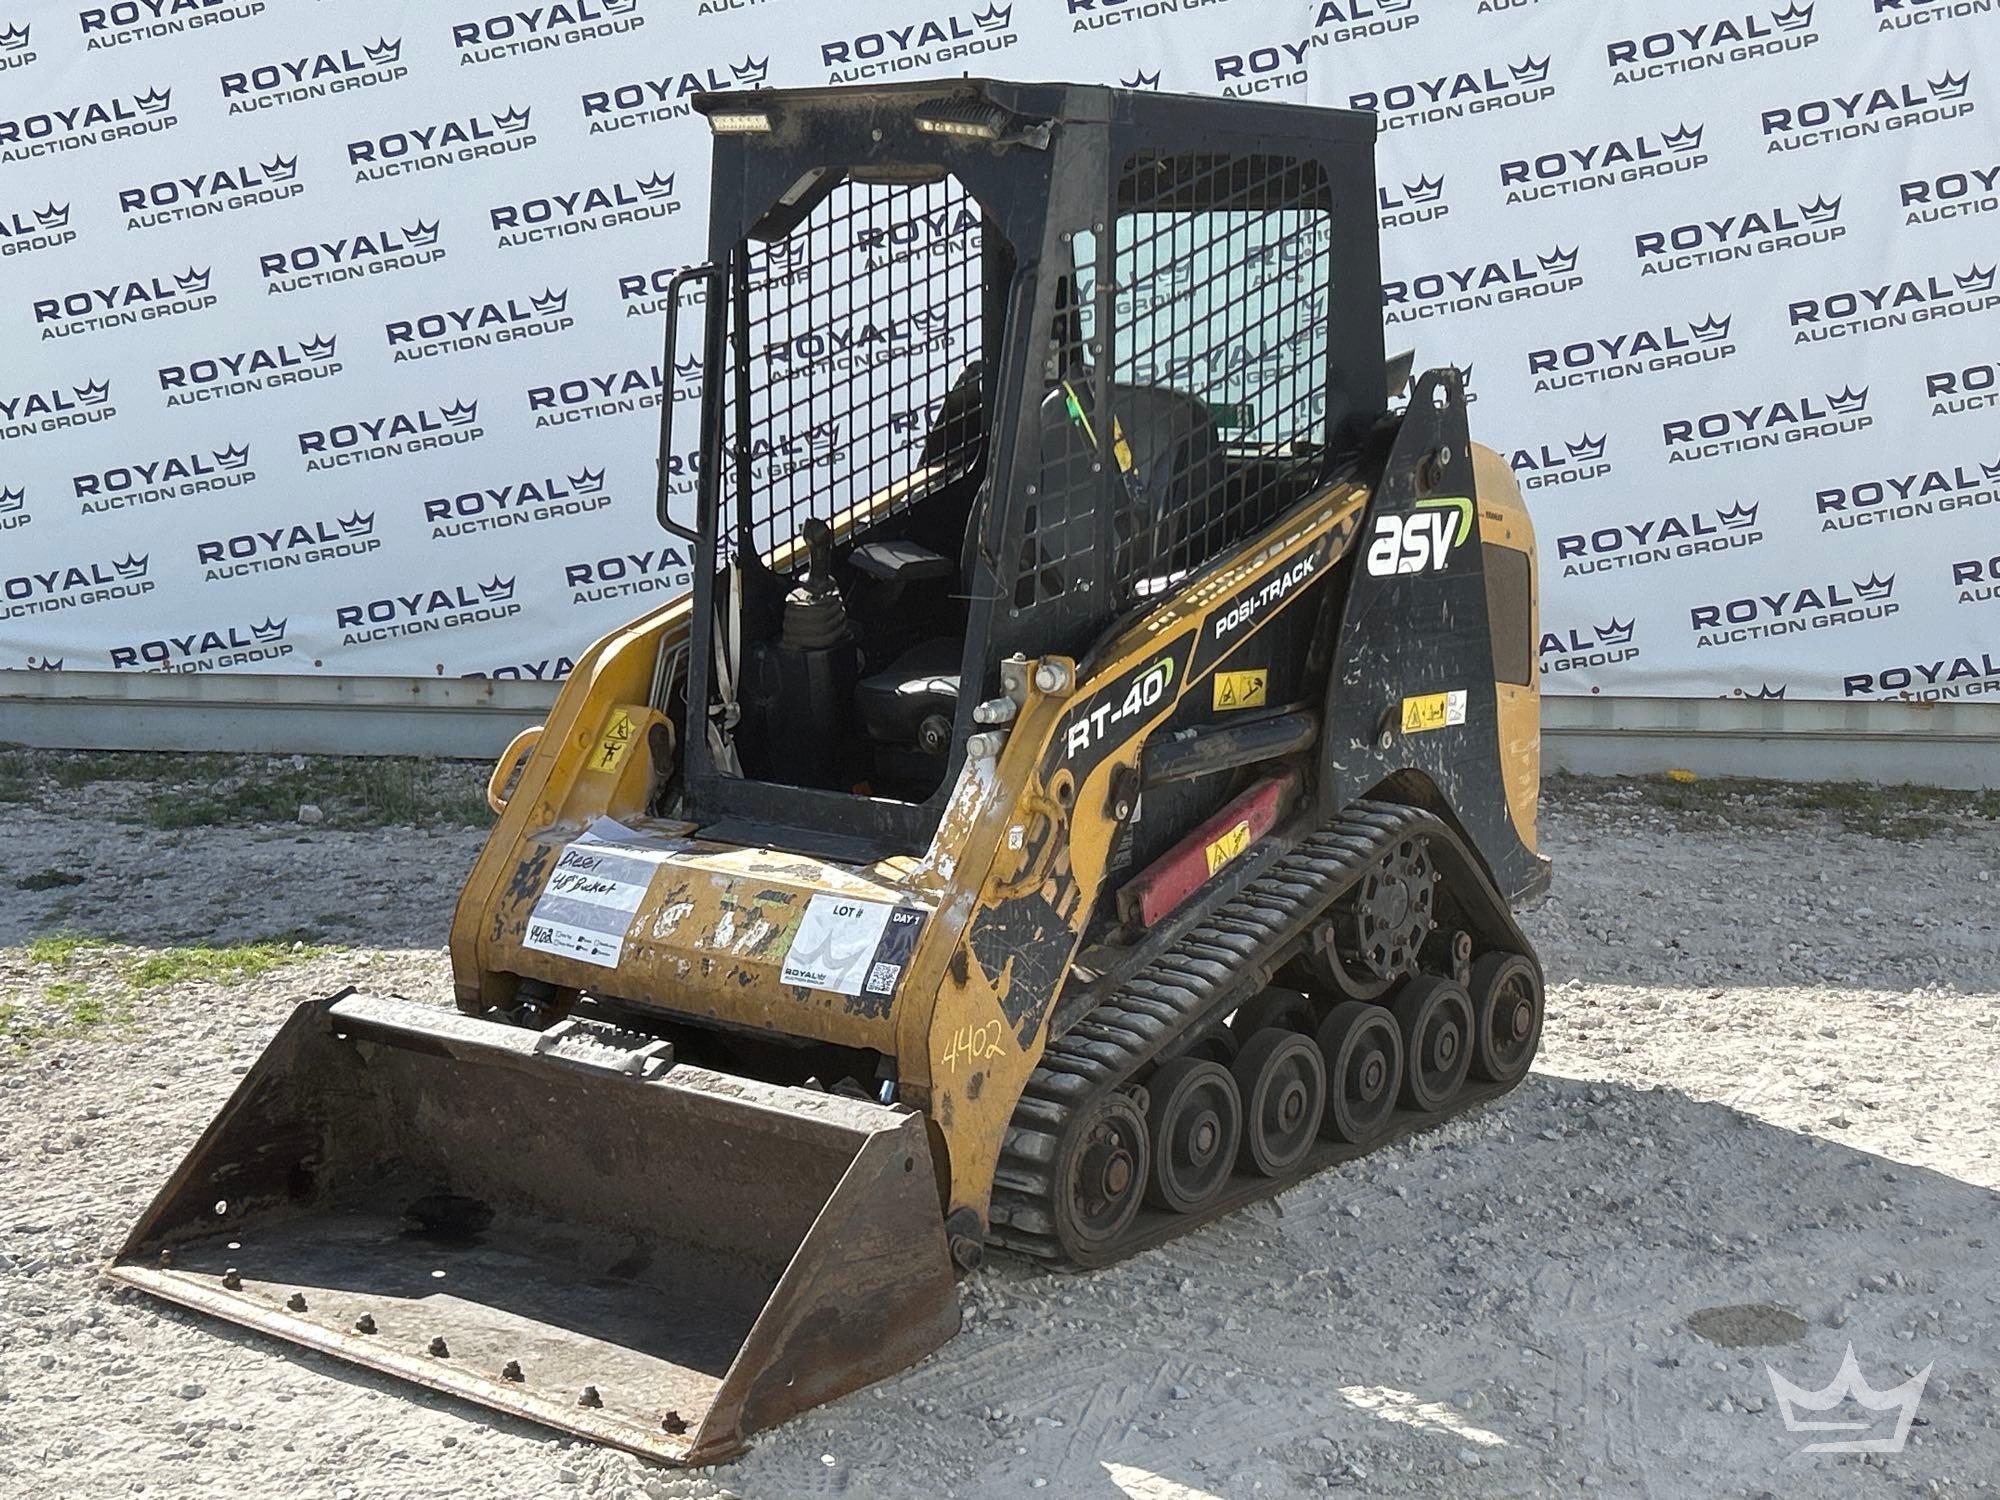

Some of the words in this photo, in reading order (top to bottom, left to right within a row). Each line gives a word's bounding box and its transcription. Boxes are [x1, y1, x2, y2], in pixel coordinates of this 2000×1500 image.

[87, 20, 184, 51] AUCTION
[188, 2, 265, 28] GROUP
[453, 0, 601, 48] ROYAL
[1073, 0, 1178, 33] AUCTION
[1334, 15, 1419, 42] GROUP
[1879, 0, 1991, 32] AUCTION
[461, 34, 560, 66] AUCTION
[565, 17, 644, 43] GROUP
[821, 17, 973, 67] ROYAL
[829, 52, 931, 85] AUCTION
[936, 34, 1017, 62] GROUP
[1215, 39, 1310, 81] ROY
[1607, 15, 1771, 67] ROYAL
[1613, 52, 1724, 86] AUCTION
[1730, 34, 1818, 61] GROUP
[220, 50, 365, 97] ROYAL
[229, 84, 326, 116] AUCTION
[330, 67, 407, 93] GROUP
[581, 69, 731, 117] ROYAL
[1223, 70, 1307, 98] AUCTIO
[0, 99, 136, 145] ROYAL
[590, 103, 690, 135] AUCTION
[1377, 104, 1463, 132] UCTION
[1469, 86, 1555, 114] GROUP
[1761, 84, 1927, 135] ROYAL
[1767, 121, 1879, 154] AUCTION
[1886, 103, 1974, 130] GROUP
[2, 133, 97, 163] AUCTION
[101, 116, 177, 142] GROUP
[347, 118, 494, 165] ROYAL
[355, 152, 453, 183] AUCTION
[458, 135, 536, 161] GROUP
[1500, 136, 1662, 186] ROYAL
[119, 166, 262, 213] ROYAL
[1506, 173, 1615, 205] AUCTION
[1621, 155, 1708, 182] GROUP
[1900, 166, 2000, 207] ROY
[127, 201, 223, 231] AUCTION
[228, 184, 304, 209] GROUP
[490, 184, 638, 231] ROYAL
[498, 218, 597, 248] AUCTION
[602, 201, 681, 227] GROUP
[1381, 206, 1448, 229] ROUP
[1906, 198, 1998, 226] AUCTIO
[2, 231, 76, 256] GROUP
[260, 231, 404, 277] ROYAL
[1635, 208, 1799, 258] ROYAL
[1641, 244, 1752, 277] AUCTION
[1758, 226, 1846, 253] GROUP
[268, 265, 364, 295] AUCTION
[369, 249, 446, 274] GROUP
[1383, 258, 1537, 306] ROYAL
[33, 278, 176, 323] ROYAL
[42, 311, 137, 341] AUCTION
[141, 295, 217, 320] GROUP
[386, 300, 531, 345] ROYAL
[1385, 294, 1492, 325] AUCTION
[1498, 277, 1583, 303] GROUP
[1789, 277, 1953, 326] ROYAL
[1794, 313, 1906, 345] AUCTION
[1912, 296, 2000, 322] GROUP
[394, 333, 491, 363] AUCTION
[496, 317, 574, 342] GROUP
[1528, 326, 1689, 375] ROYAL
[158, 345, 301, 390] ROYAL
[167, 379, 262, 408] AUCTION
[267, 363, 343, 387] GROUP
[1534, 362, 1643, 393] AUCTION
[1649, 345, 1736, 371] GROUP
[0, 390, 75, 420] YAL
[41, 407, 116, 431] GROUP
[536, 399, 634, 429] AUCTION
[1663, 398, 1826, 445] ROYAL
[1932, 393, 1999, 416] AUCT
[298, 410, 442, 455] ROYAL
[306, 443, 402, 472] AUCTION
[407, 428, 484, 452] GROUP
[1669, 433, 1779, 464] AUCTION
[1785, 416, 1873, 443] GROUP
[73, 454, 214, 498] ROYAL
[81, 487, 176, 515] AUCTION
[180, 472, 256, 496] GROUP
[1526, 464, 1611, 489] GROUP
[1816, 467, 1980, 514] ROYAL
[424, 479, 569, 522] ROYAL
[432, 511, 529, 539] AUCTION
[534, 496, 611, 520] GROUP
[1822, 502, 1933, 532] AUCTION
[1939, 490, 2000, 511] GRO
[197, 522, 340, 565] ROYAL
[1557, 513, 1717, 560] ROYAL
[1563, 547, 1671, 578] AUCTION
[1677, 532, 1763, 557] GROUP
[5, 564, 114, 600] OYAL
[205, 554, 301, 582] AUCTION
[305, 539, 381, 563] GROUP
[565, 546, 691, 587] ROYA
[0, 596, 76, 620] UCTION
[80, 581, 155, 604] GROUP
[336, 586, 479, 629] ROYAL
[573, 576, 671, 605] AUCTION
[1215, 556, 1315, 639] POSI-TRACK
[1691, 585, 1853, 630] ROYAL
[343, 618, 440, 646] AUCTION
[444, 604, 521, 627] GROUP
[1697, 619, 1806, 648] AUCTION
[1812, 603, 1899, 628] GROUP
[109, 628, 251, 669] ROYAL
[218, 645, 293, 667] GROUP
[1554, 648, 1639, 671] GROUP
[1066, 670, 1164, 760] RT-40
[832, 905, 855, 917] LOT
[893, 913, 914, 923] DAY
[785, 968, 816, 980] ROYAL
[941, 1019, 1007, 1073] 4402
